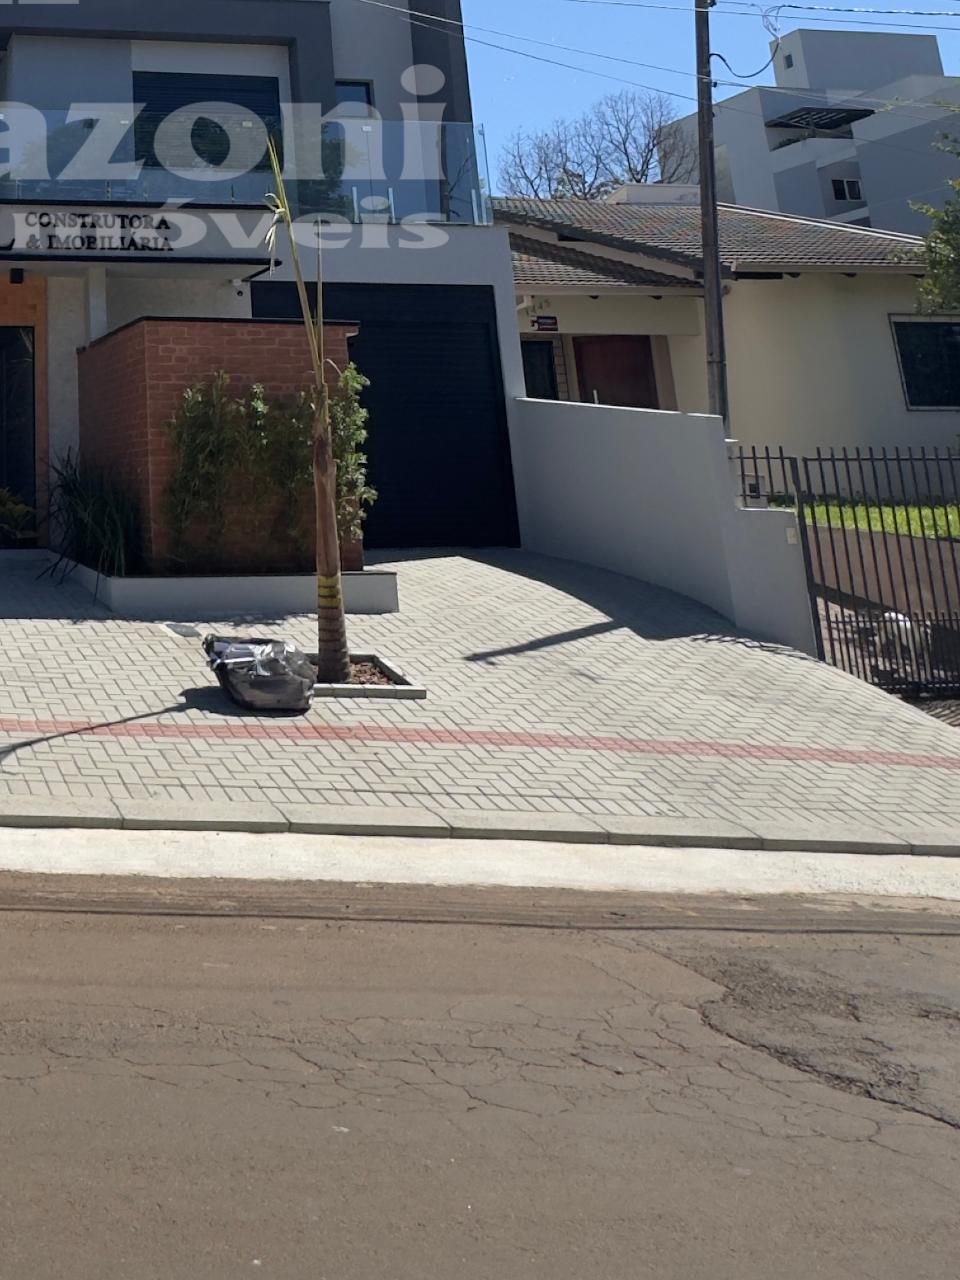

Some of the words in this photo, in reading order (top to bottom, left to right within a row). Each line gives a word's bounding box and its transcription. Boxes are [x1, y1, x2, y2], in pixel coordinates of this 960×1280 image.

[25, 212, 171, 230] CONSTRUTORA
[26, 234, 41, 249] &
[47, 231, 174, 251] IMOBILIÁRIA
